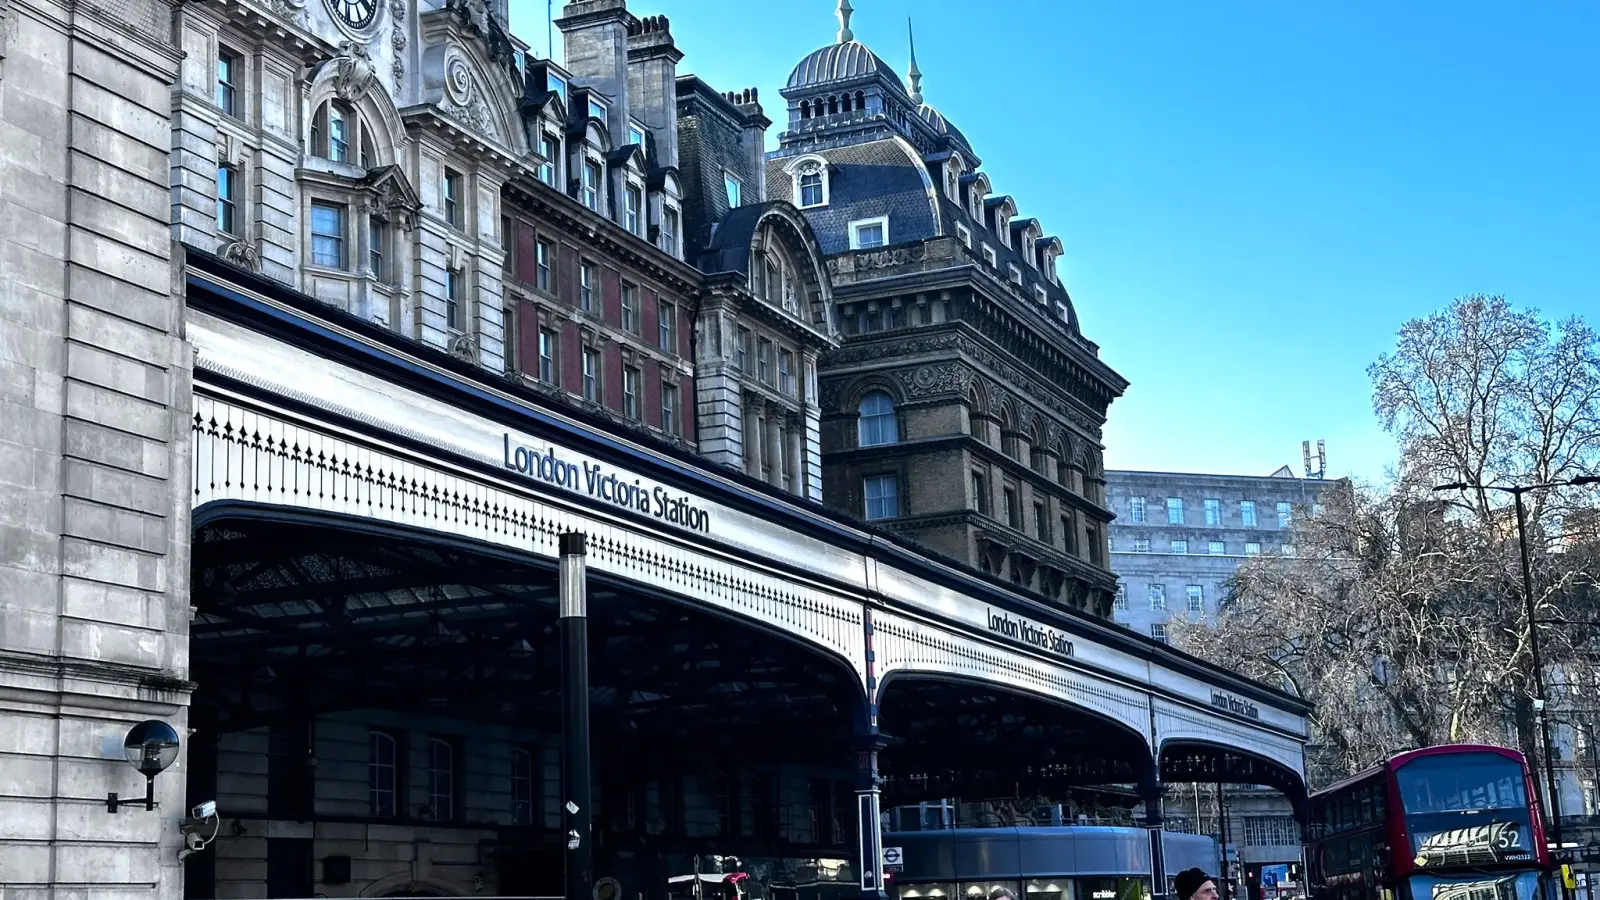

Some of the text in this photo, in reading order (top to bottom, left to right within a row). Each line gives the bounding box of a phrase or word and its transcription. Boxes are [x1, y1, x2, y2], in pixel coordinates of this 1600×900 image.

[504, 433, 710, 534] London Victoria Station
[987, 607, 1074, 658] London Victoria Station
[1210, 688, 1228, 709] London
[1499, 831, 1521, 849] 52
